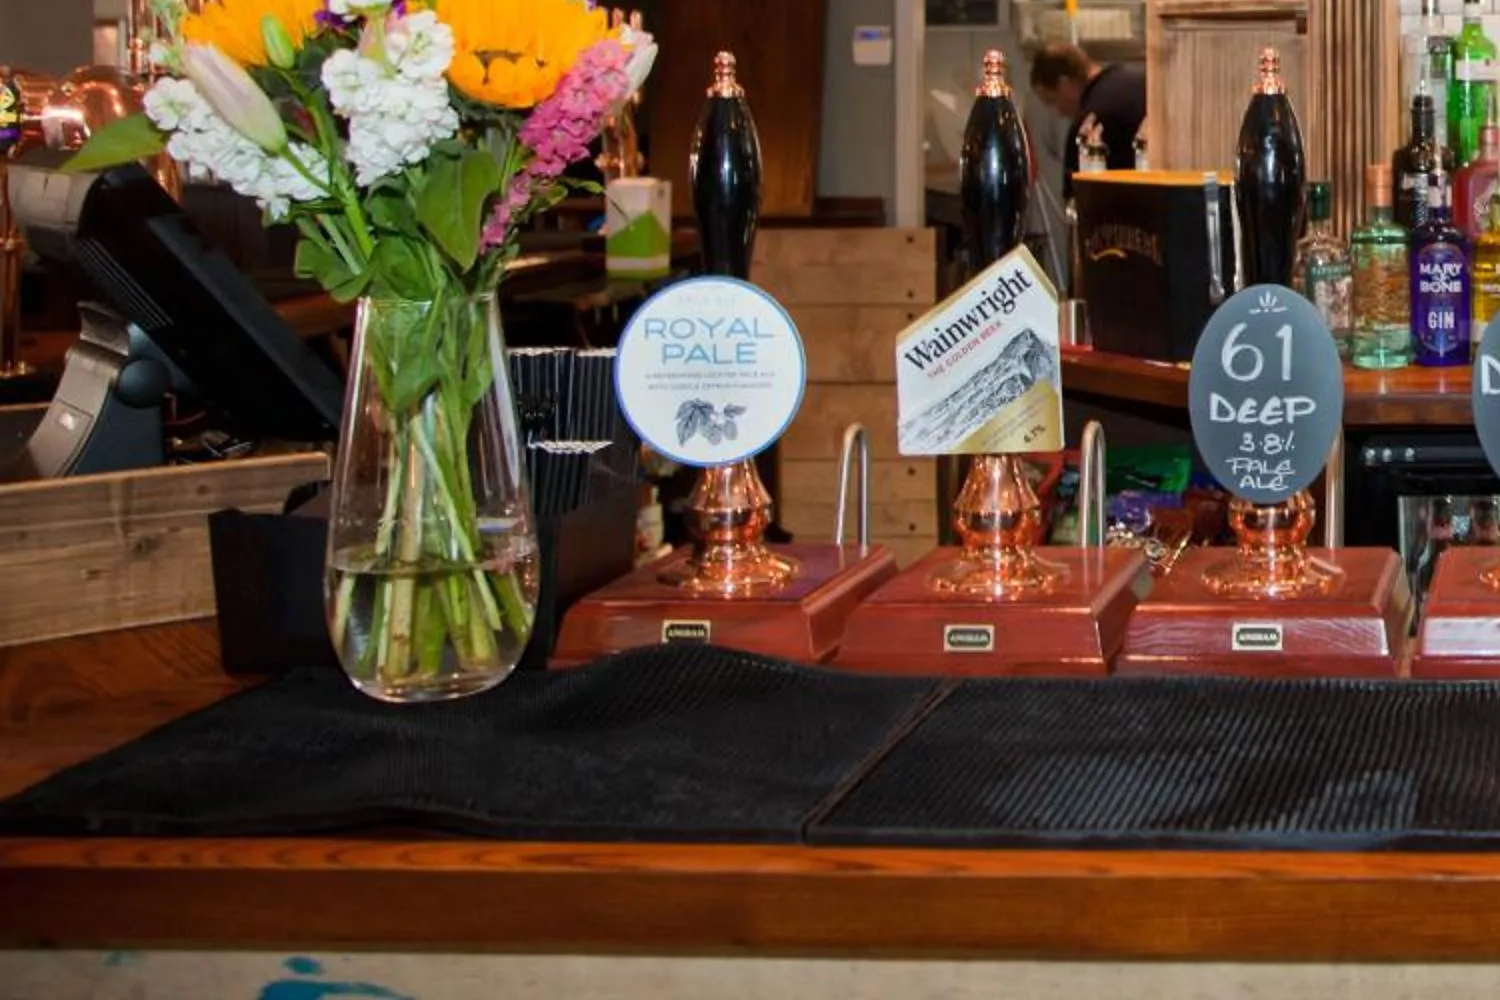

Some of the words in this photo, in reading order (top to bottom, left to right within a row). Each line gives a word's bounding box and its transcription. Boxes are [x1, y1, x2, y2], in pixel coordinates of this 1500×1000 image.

[1420, 263, 1462, 276] MARY
[1420, 281, 1462, 293] BONE
[644, 317, 775, 340] ROYAL
[904, 267, 1032, 371] Wainwright
[1428, 311, 1455, 329] GIN
[662, 343, 757, 365] PALE
[1221, 322, 1294, 382] 61
[1209, 392, 1317, 425] DEEP
[1225, 457, 1295, 475] PALE
[1239, 474, 1289, 491] ALE
